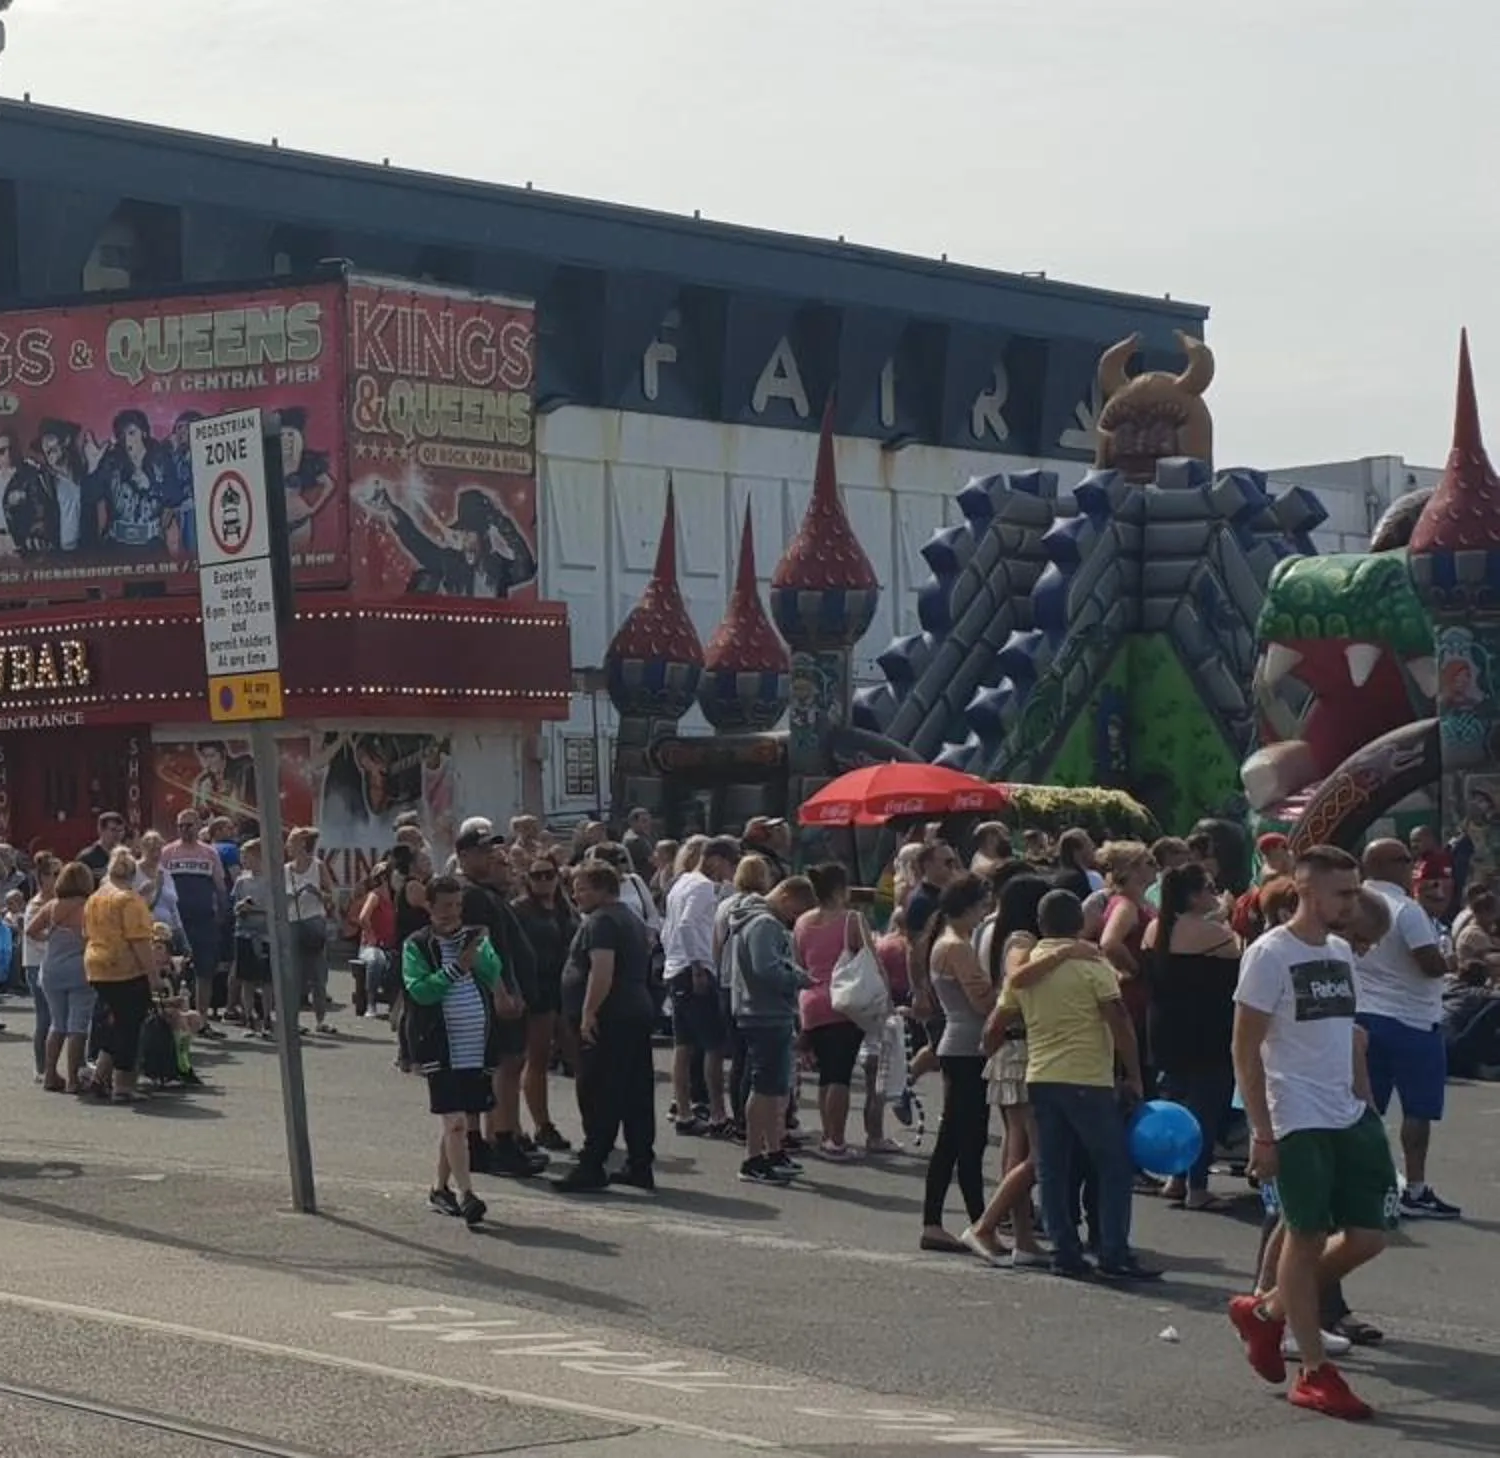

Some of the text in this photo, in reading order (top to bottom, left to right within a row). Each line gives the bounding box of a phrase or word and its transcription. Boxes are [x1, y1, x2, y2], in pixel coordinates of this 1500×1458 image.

[69, 340, 93, 370] &
[106, 302, 323, 386] QUEENS
[353, 300, 534, 390] KINGS
[152, 366, 321, 393] AT CENTRAL PIER
[353, 375, 532, 446] & QUEENS
[195, 415, 255, 440] PEDESTRIAN
[205, 438, 247, 466] ZONE
[213, 570, 243, 585] Except
[220, 586, 252, 601] loading
[231, 619, 247, 632] and
[239, 634, 272, 649] holders
[247, 652, 267, 665] time
[317, 847, 393, 886] KIN
